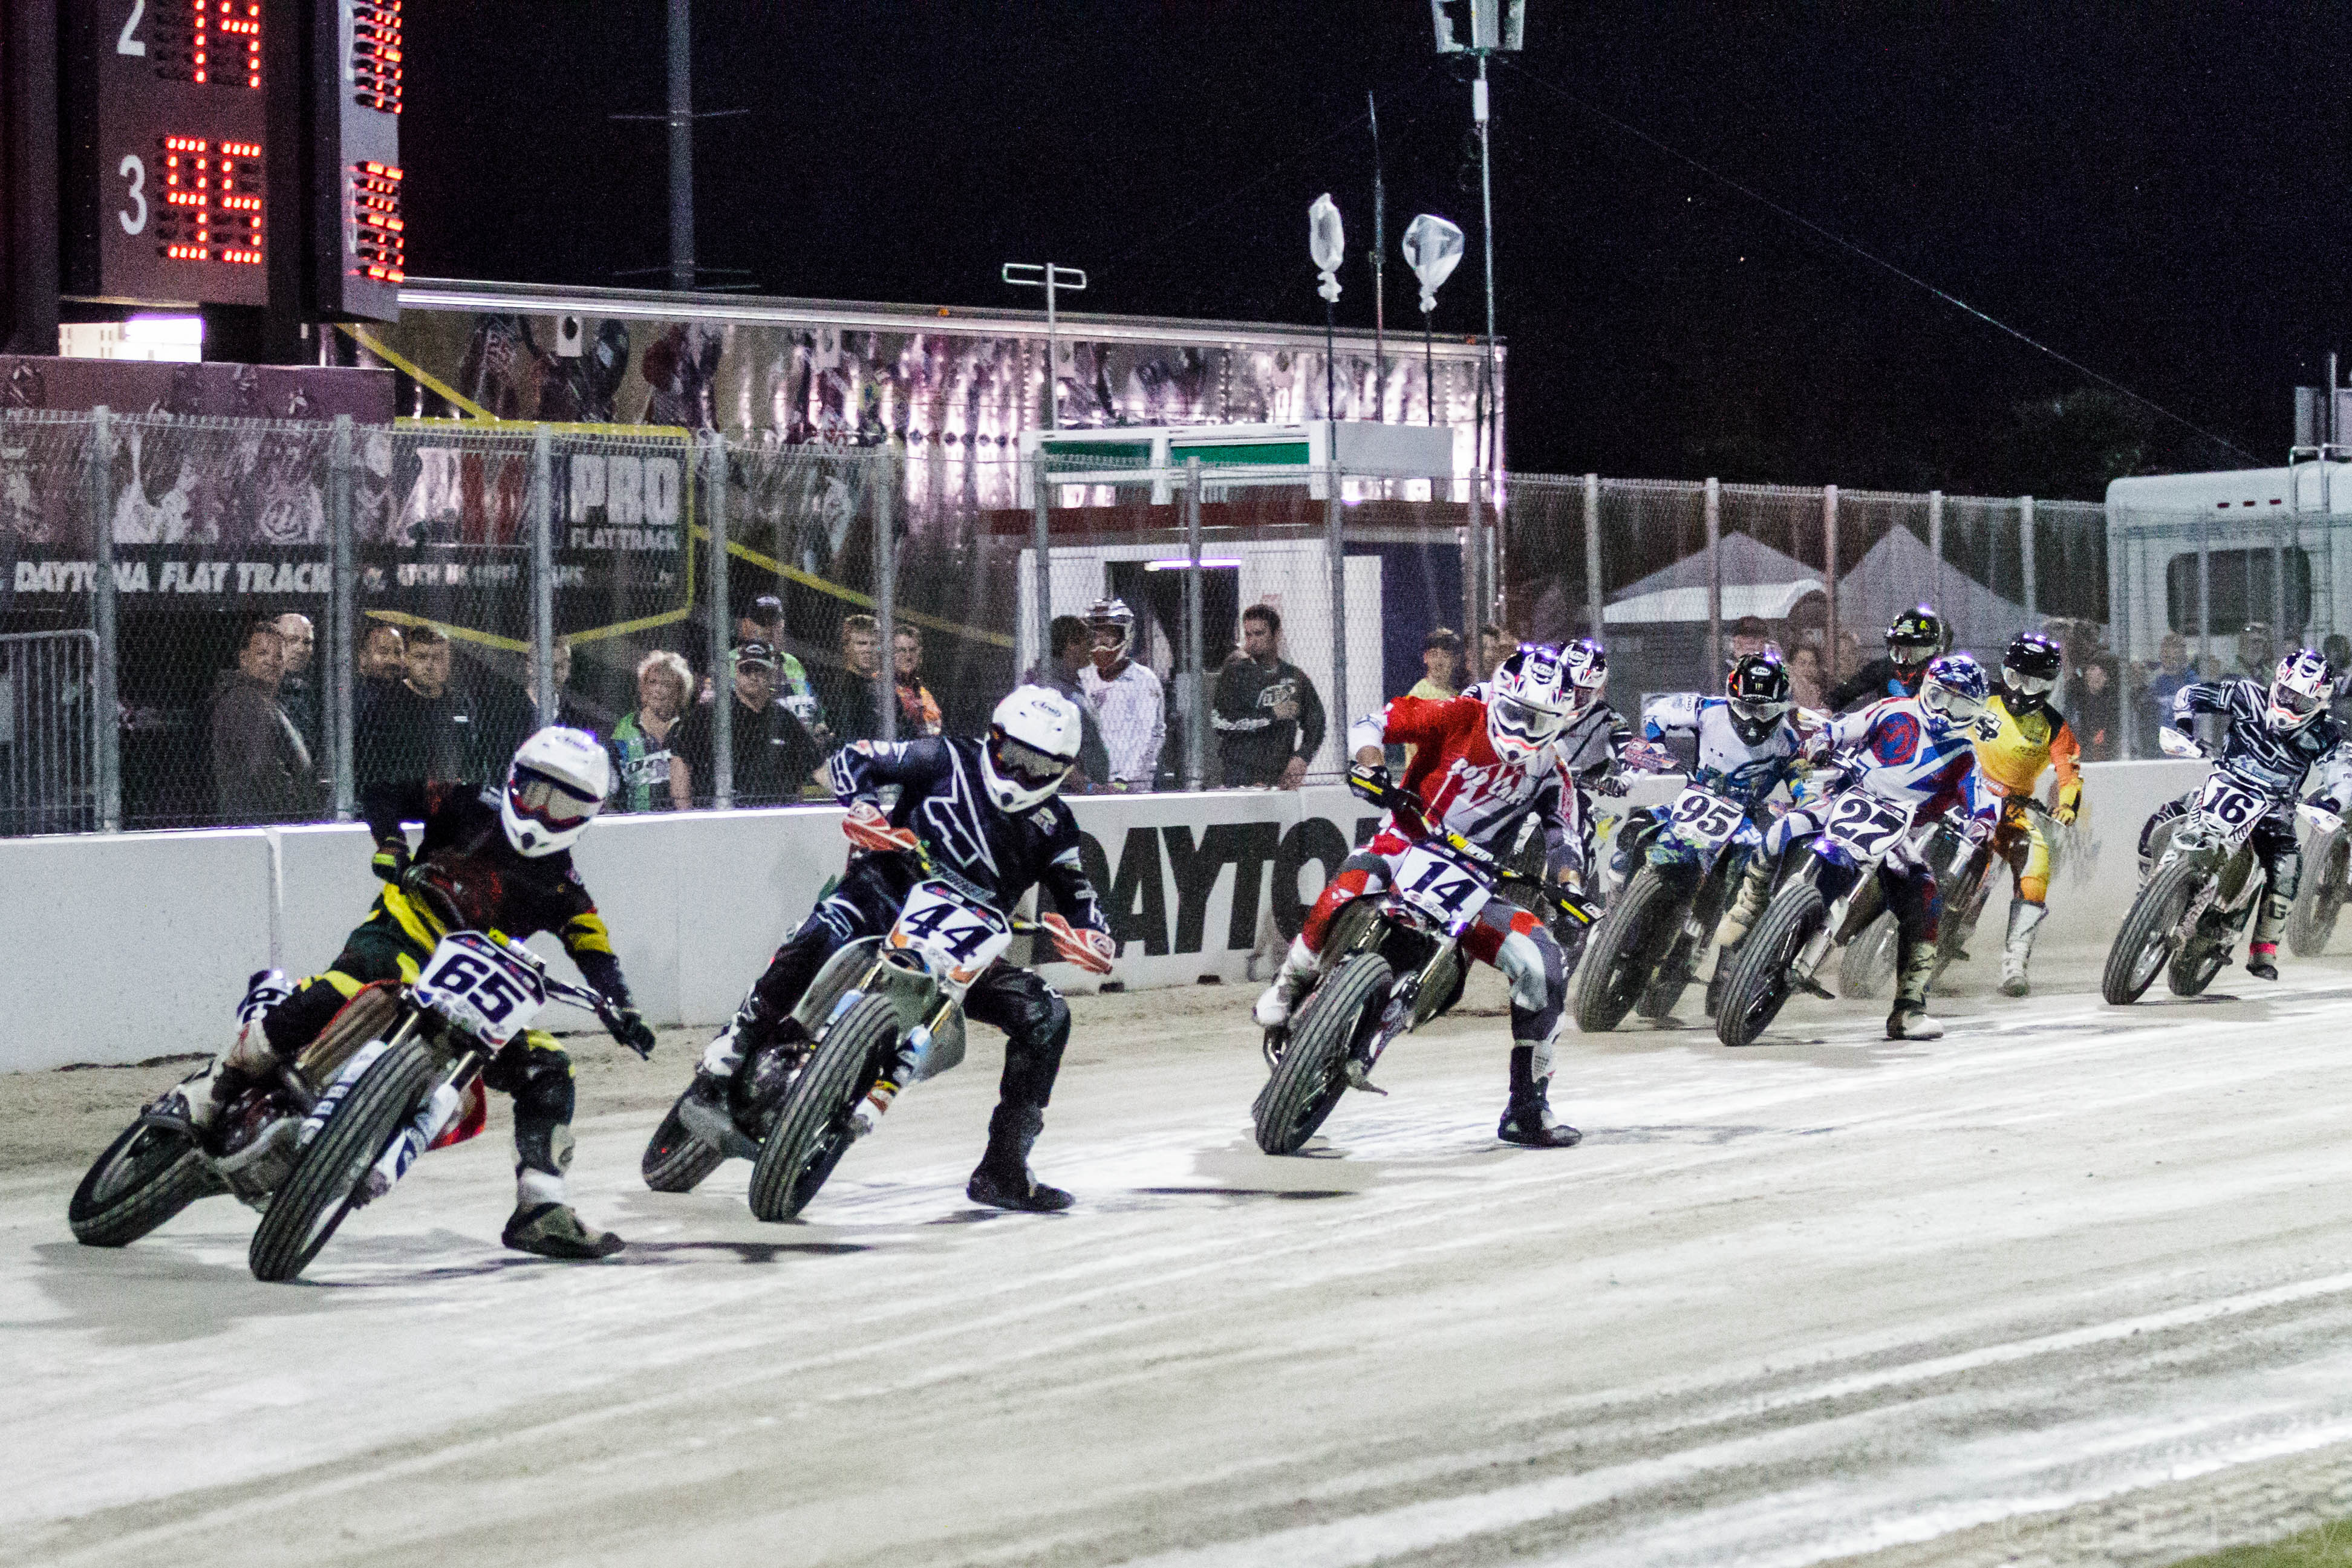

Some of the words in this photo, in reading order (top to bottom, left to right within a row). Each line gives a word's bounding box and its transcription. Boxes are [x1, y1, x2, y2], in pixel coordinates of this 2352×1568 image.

[119, 154, 147, 235] 3
[166, 137, 262, 264] 95
[570, 454, 680, 525] PRO
[158, 562, 230, 593] FLAT
[236, 562, 333, 593] TRACK
[1673, 795, 1740, 836] 95
[1830, 798, 1904, 856] 27
[2201, 786, 2255, 824] 16
[1032, 817, 1381, 965] DAYTO
[1404, 861, 1479, 912] 14
[905, 903, 995, 964] 44
[428, 953, 526, 1023] 65
